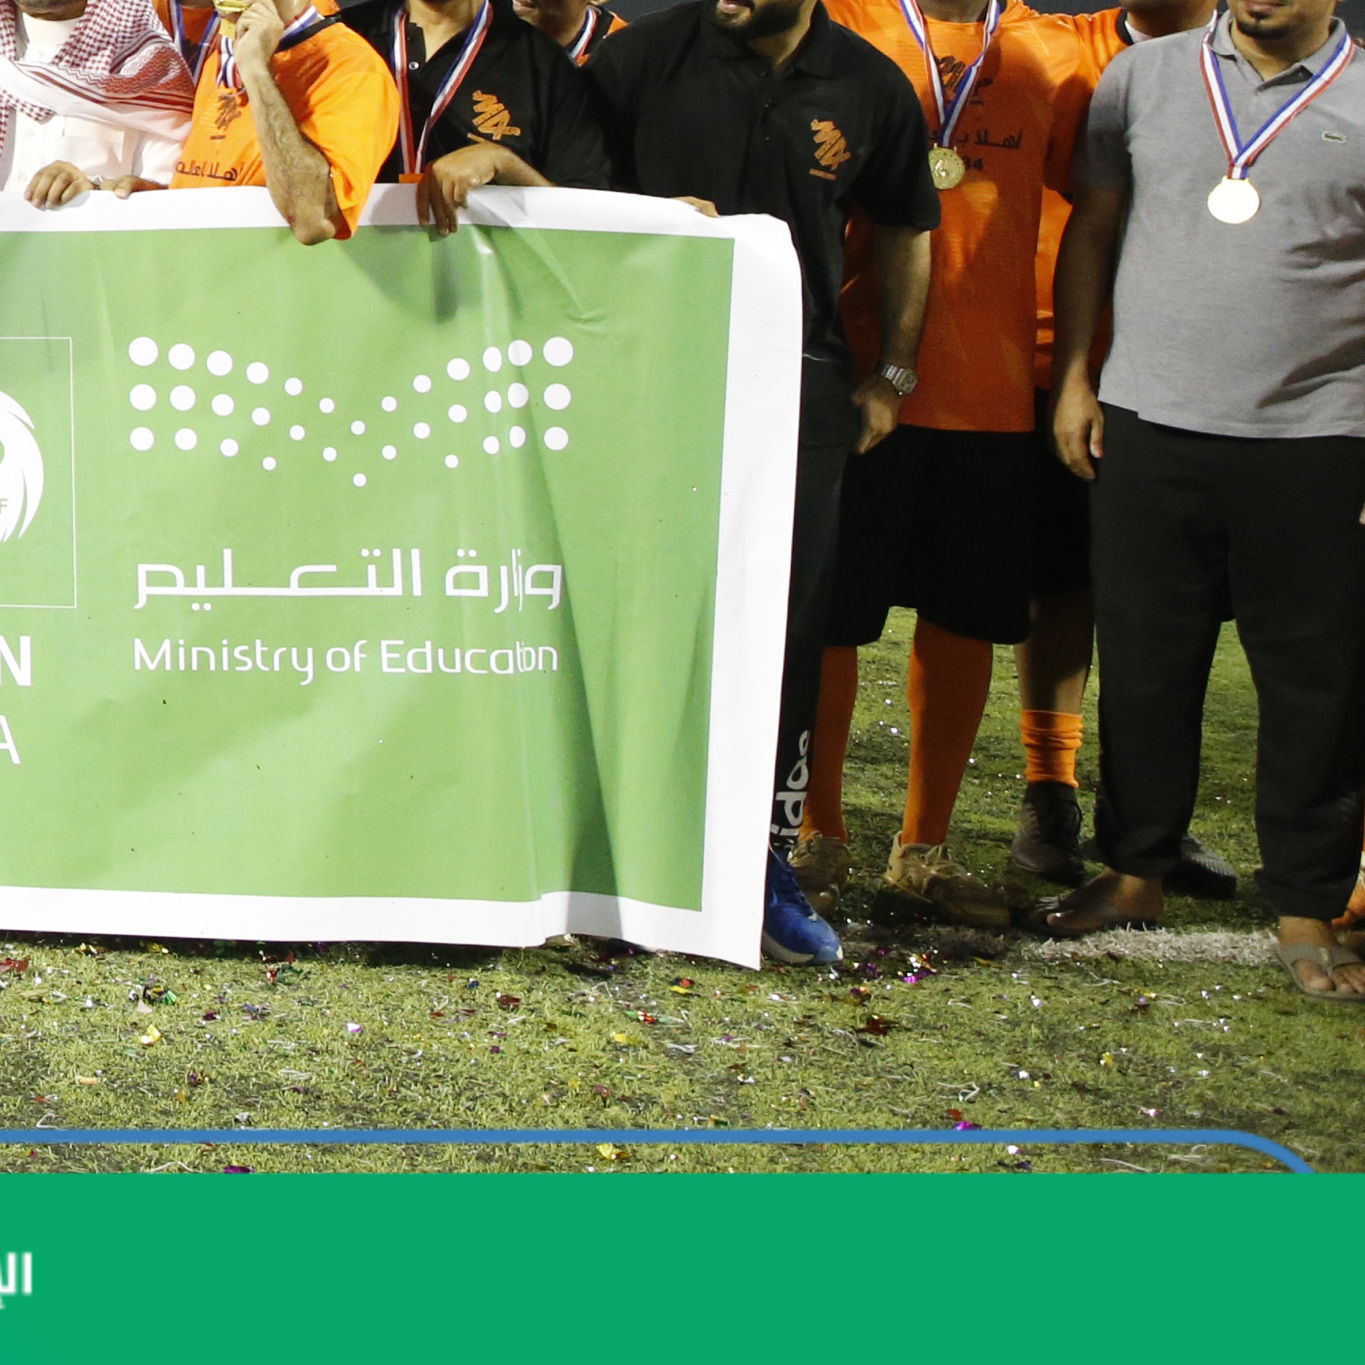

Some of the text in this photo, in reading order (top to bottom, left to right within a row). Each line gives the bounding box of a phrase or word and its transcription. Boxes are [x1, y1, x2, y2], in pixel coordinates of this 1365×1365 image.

[133, 547, 563, 614] وزارة التعليم
[133, 637, 314, 686] Ministry
[325, 639, 368, 673] of
